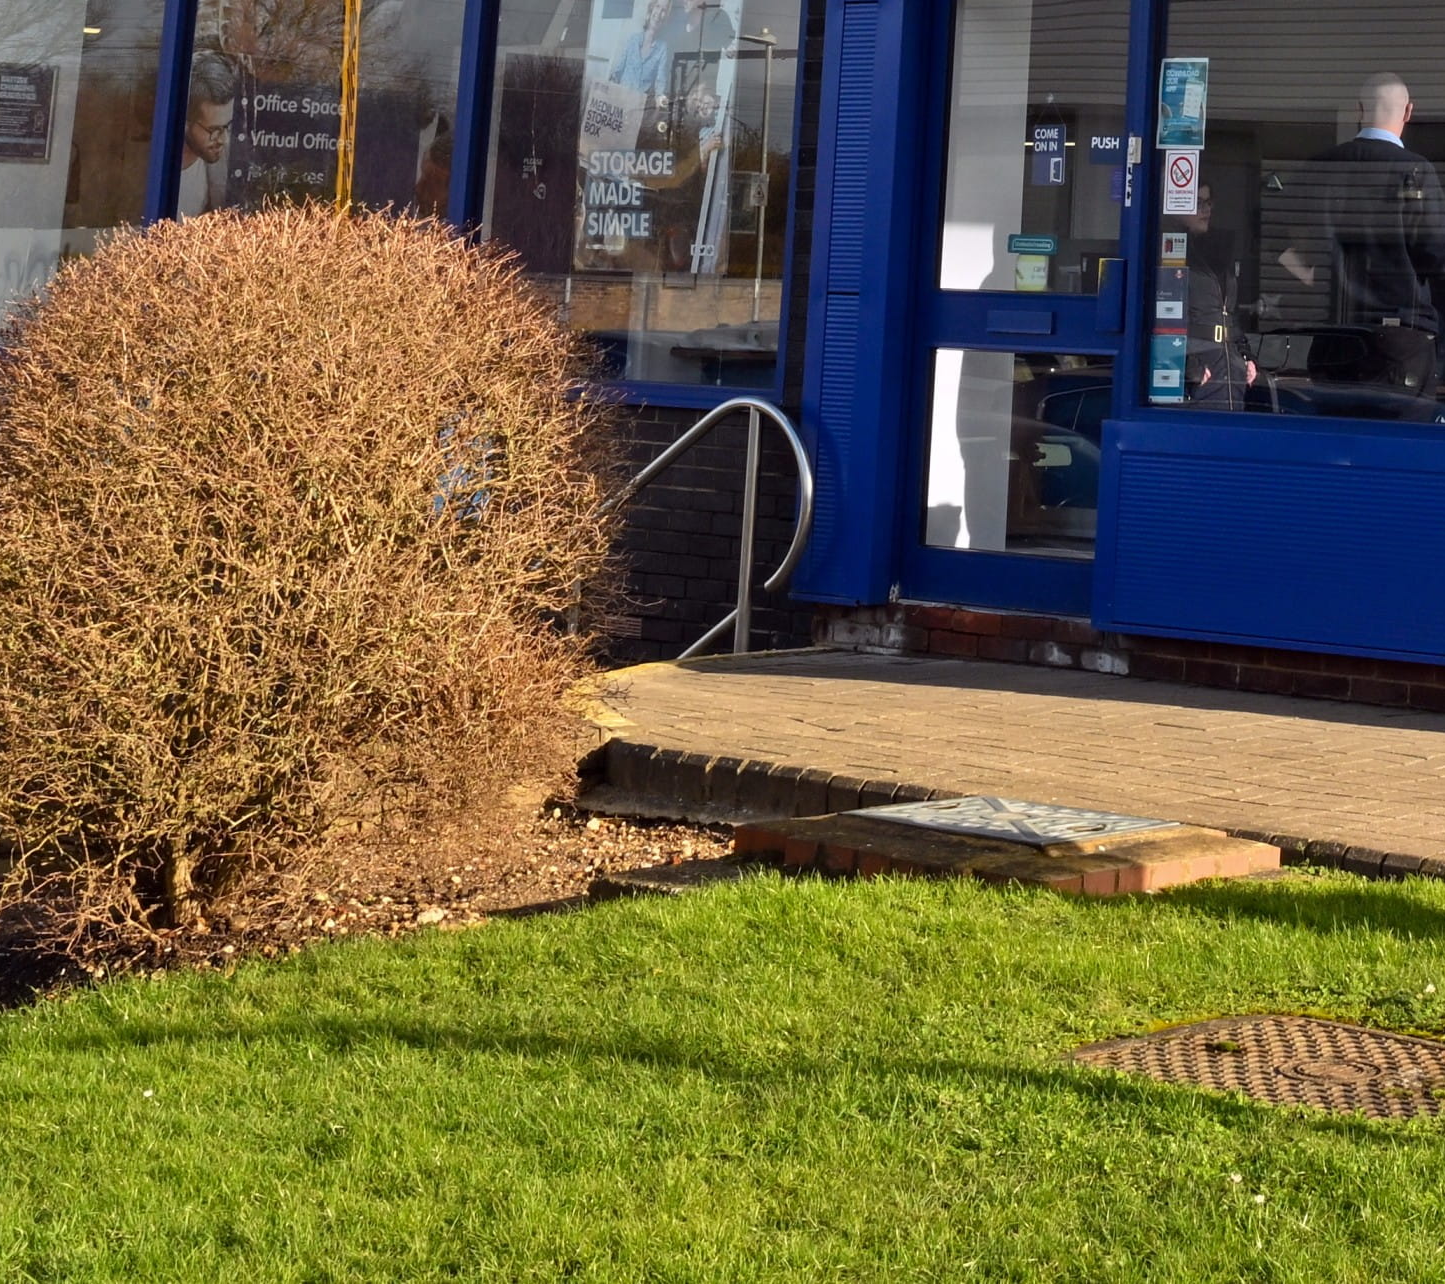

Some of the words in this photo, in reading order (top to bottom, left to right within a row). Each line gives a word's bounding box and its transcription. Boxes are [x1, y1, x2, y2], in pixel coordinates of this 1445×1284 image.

[254, 94, 298, 113] Office
[301, 98, 347, 119] Space
[590, 97, 624, 120] MEDIUM
[584, 121, 602, 138] BOX
[587, 109, 624, 133] STORAGE
[250, 130, 299, 148] Virtual
[302, 133, 353, 151] Offices
[1034, 128, 1059, 140] COME
[1091, 136, 1120, 150] PUSH
[1034, 141, 1048, 152] ON
[1048, 141, 1058, 152] IN
[589, 150, 674, 176] STORAGE
[588, 182, 642, 206] MADE
[587, 212, 650, 238] SIMPLE
